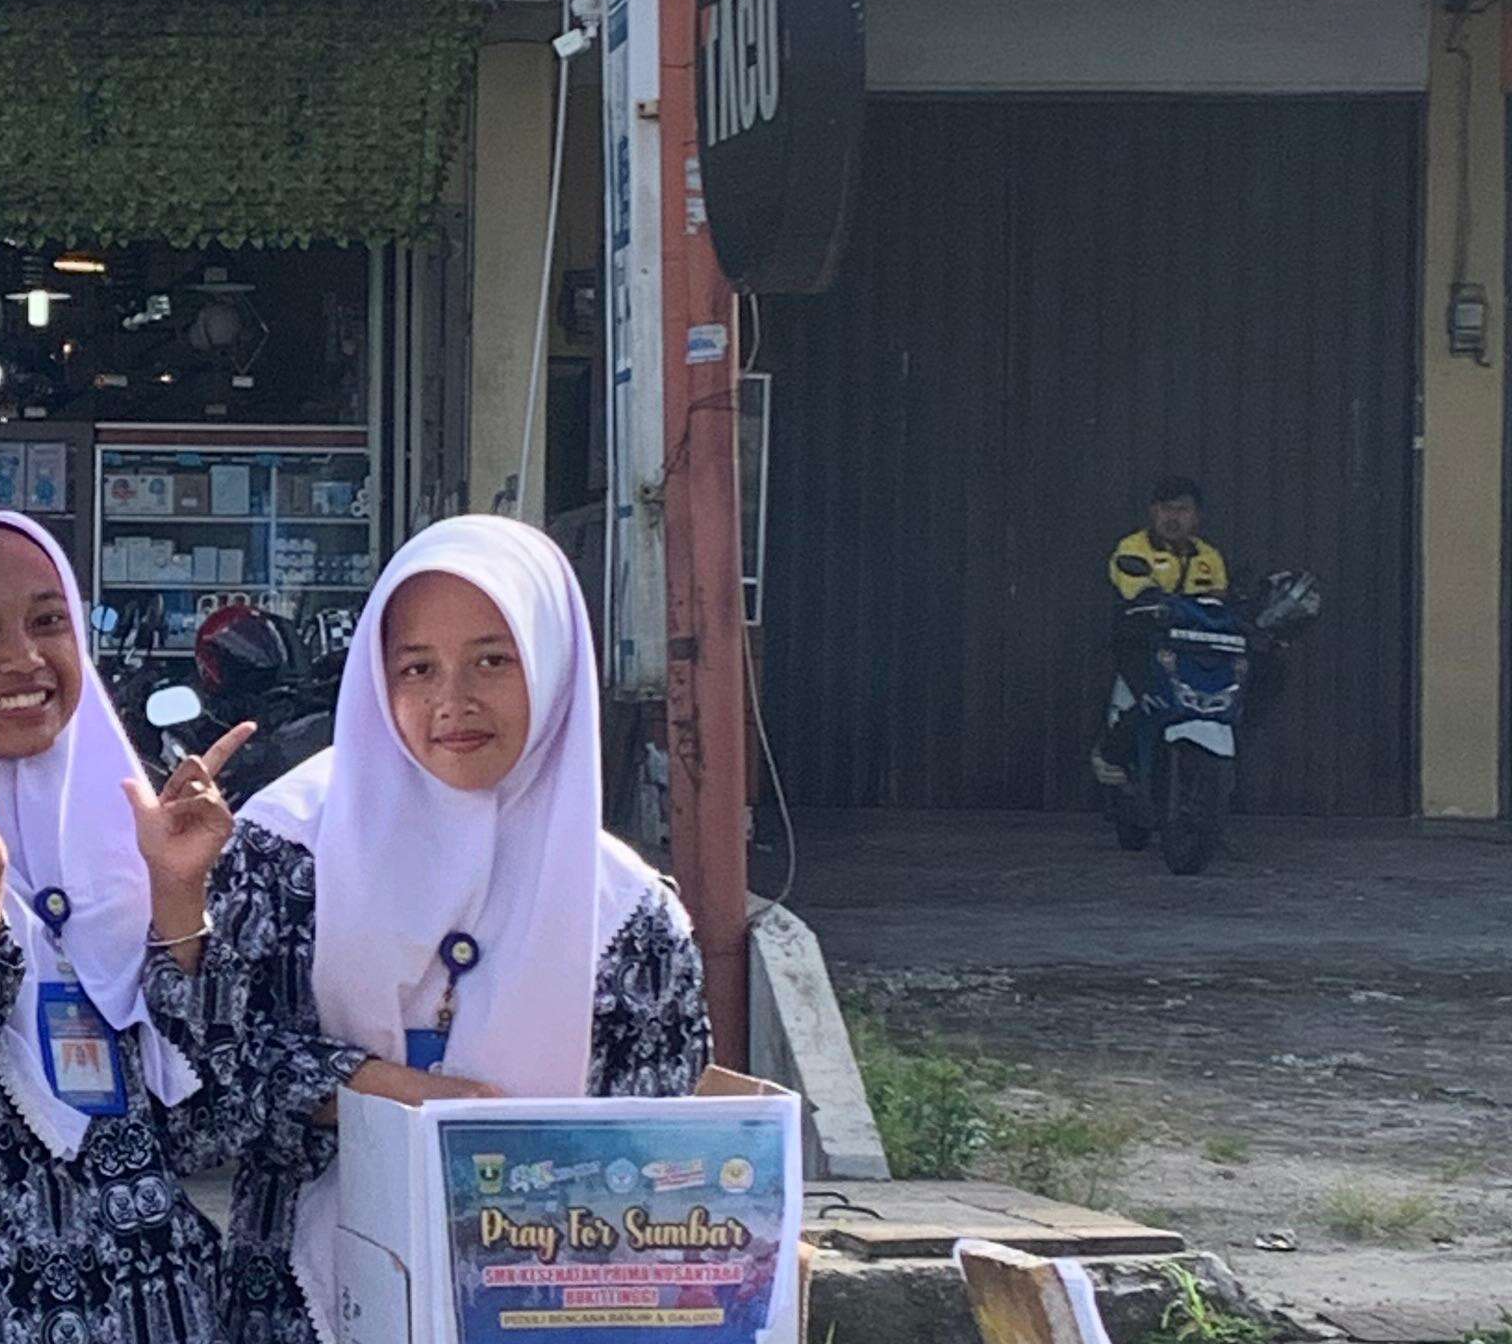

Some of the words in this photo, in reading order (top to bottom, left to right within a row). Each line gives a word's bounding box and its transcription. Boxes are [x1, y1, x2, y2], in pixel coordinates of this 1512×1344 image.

[480, 1207, 559, 1262] Pray
[568, 1207, 615, 1248] For
[624, 1206, 747, 1249] Sumbar
